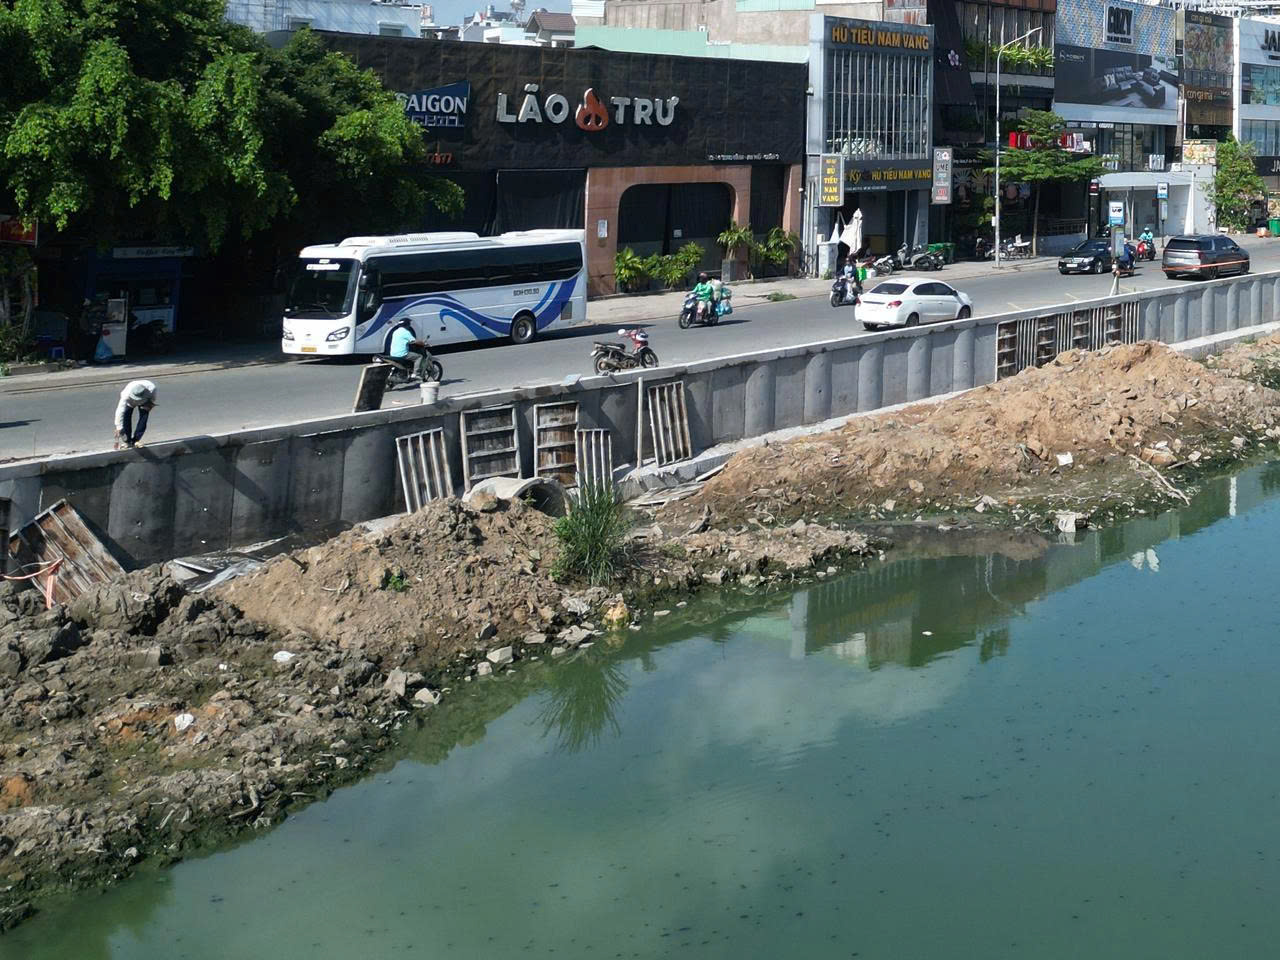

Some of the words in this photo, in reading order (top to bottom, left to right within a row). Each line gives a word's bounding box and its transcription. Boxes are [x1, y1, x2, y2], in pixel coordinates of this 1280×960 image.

[1107, 6, 1133, 35] COZY
[877, 32, 900, 48] NAM
[902, 33, 929, 50] VANG
[396, 91, 467, 115] SAIGON
[496, 83, 569, 123] LÃO
[610, 95, 679, 126] TRƯ
[899, 169, 912, 180] NAM
[914, 168, 931, 180] VANG
[822, 195, 840, 203] VANG
